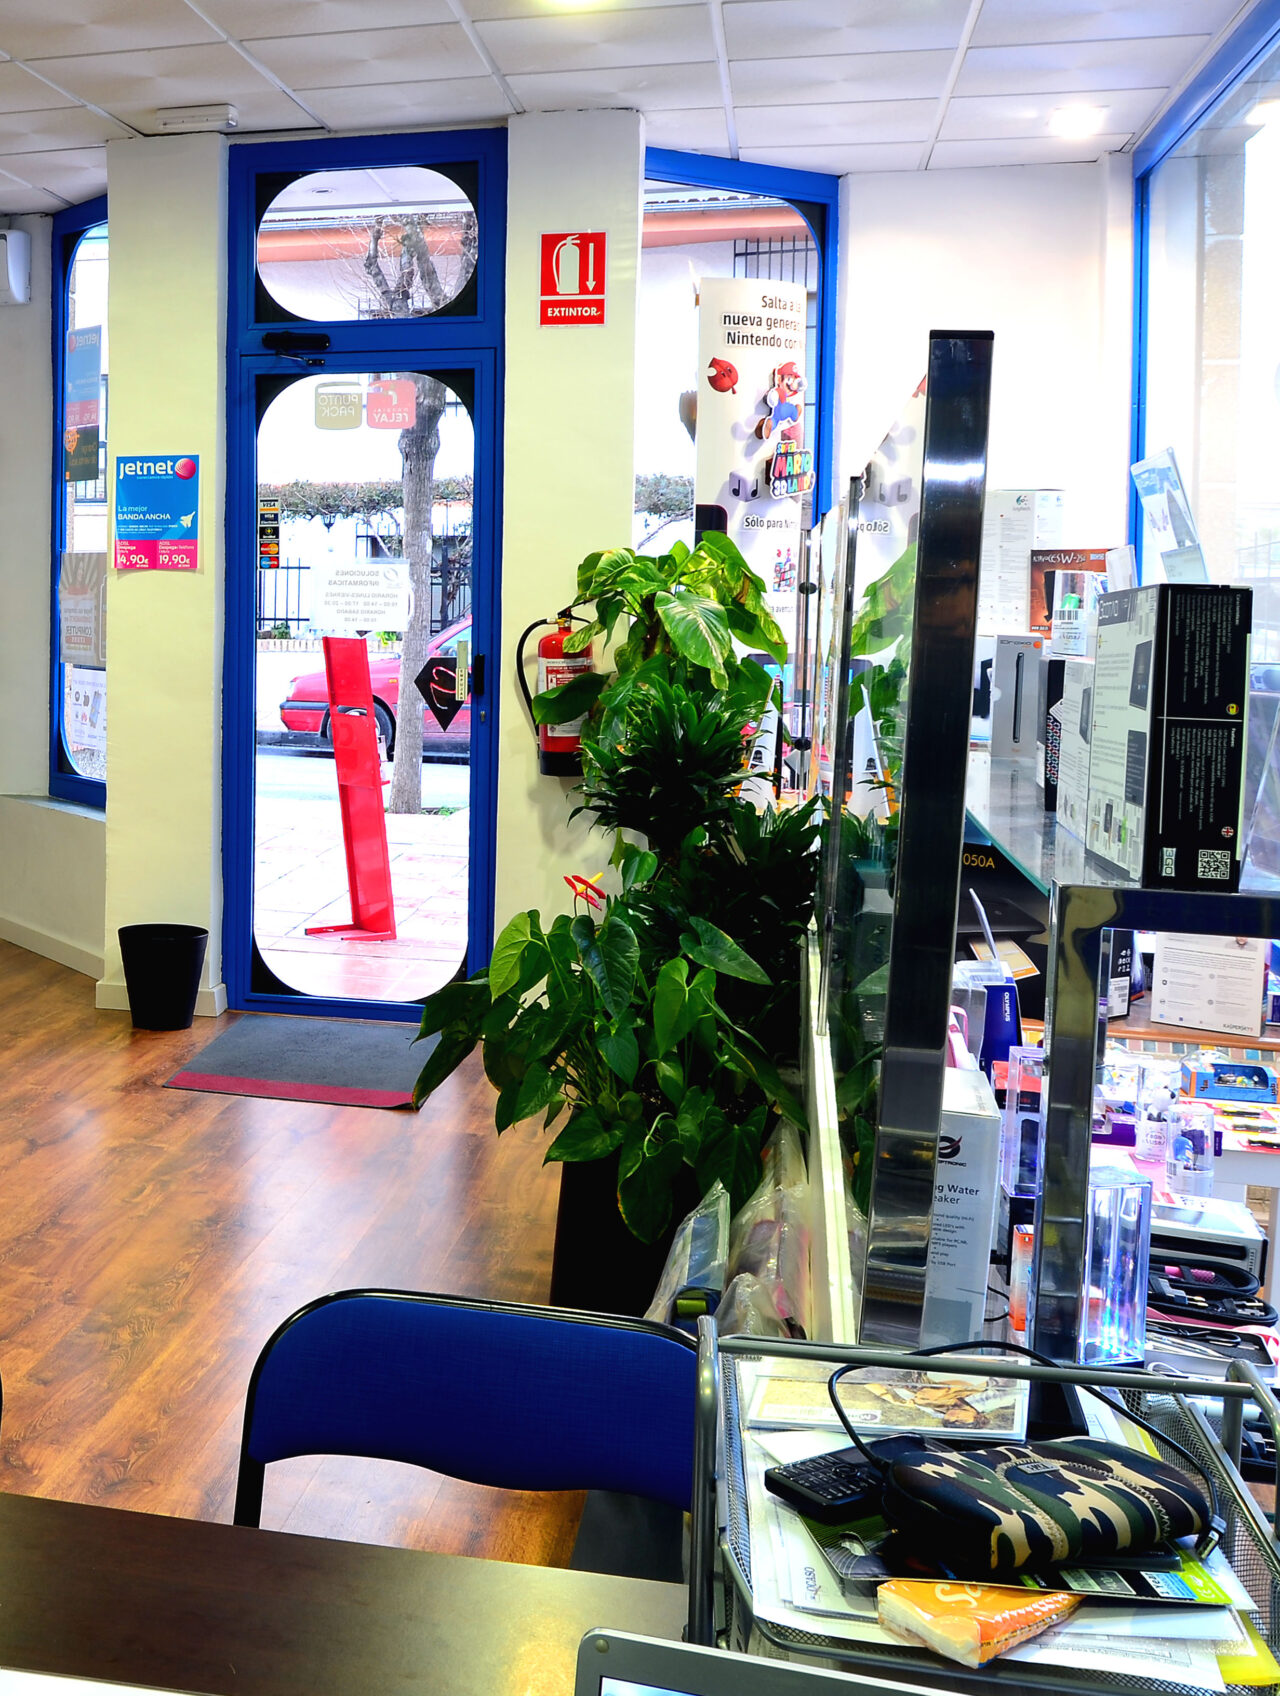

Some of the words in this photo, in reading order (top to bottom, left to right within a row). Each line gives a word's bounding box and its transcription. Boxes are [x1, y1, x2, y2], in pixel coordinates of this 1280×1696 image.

[761, 295, 787, 310] Salta
[547, 306, 597, 317] EXTINTOR
[723, 314, 763, 327] nueva
[727, 330, 782, 347] Nintendo
[119, 460, 174, 480] jetnet
[773, 453, 812, 478] MARIO
[773, 479, 787, 496] 3D
[787, 475, 811, 494] LAND
[128, 505, 148, 513] mejor
[744, 516, 764, 528] Sólo
[159, 554, 191, 565] 19,90€
[962, 853, 995, 869] 050A
[947, 1184, 980, 1196] Water
